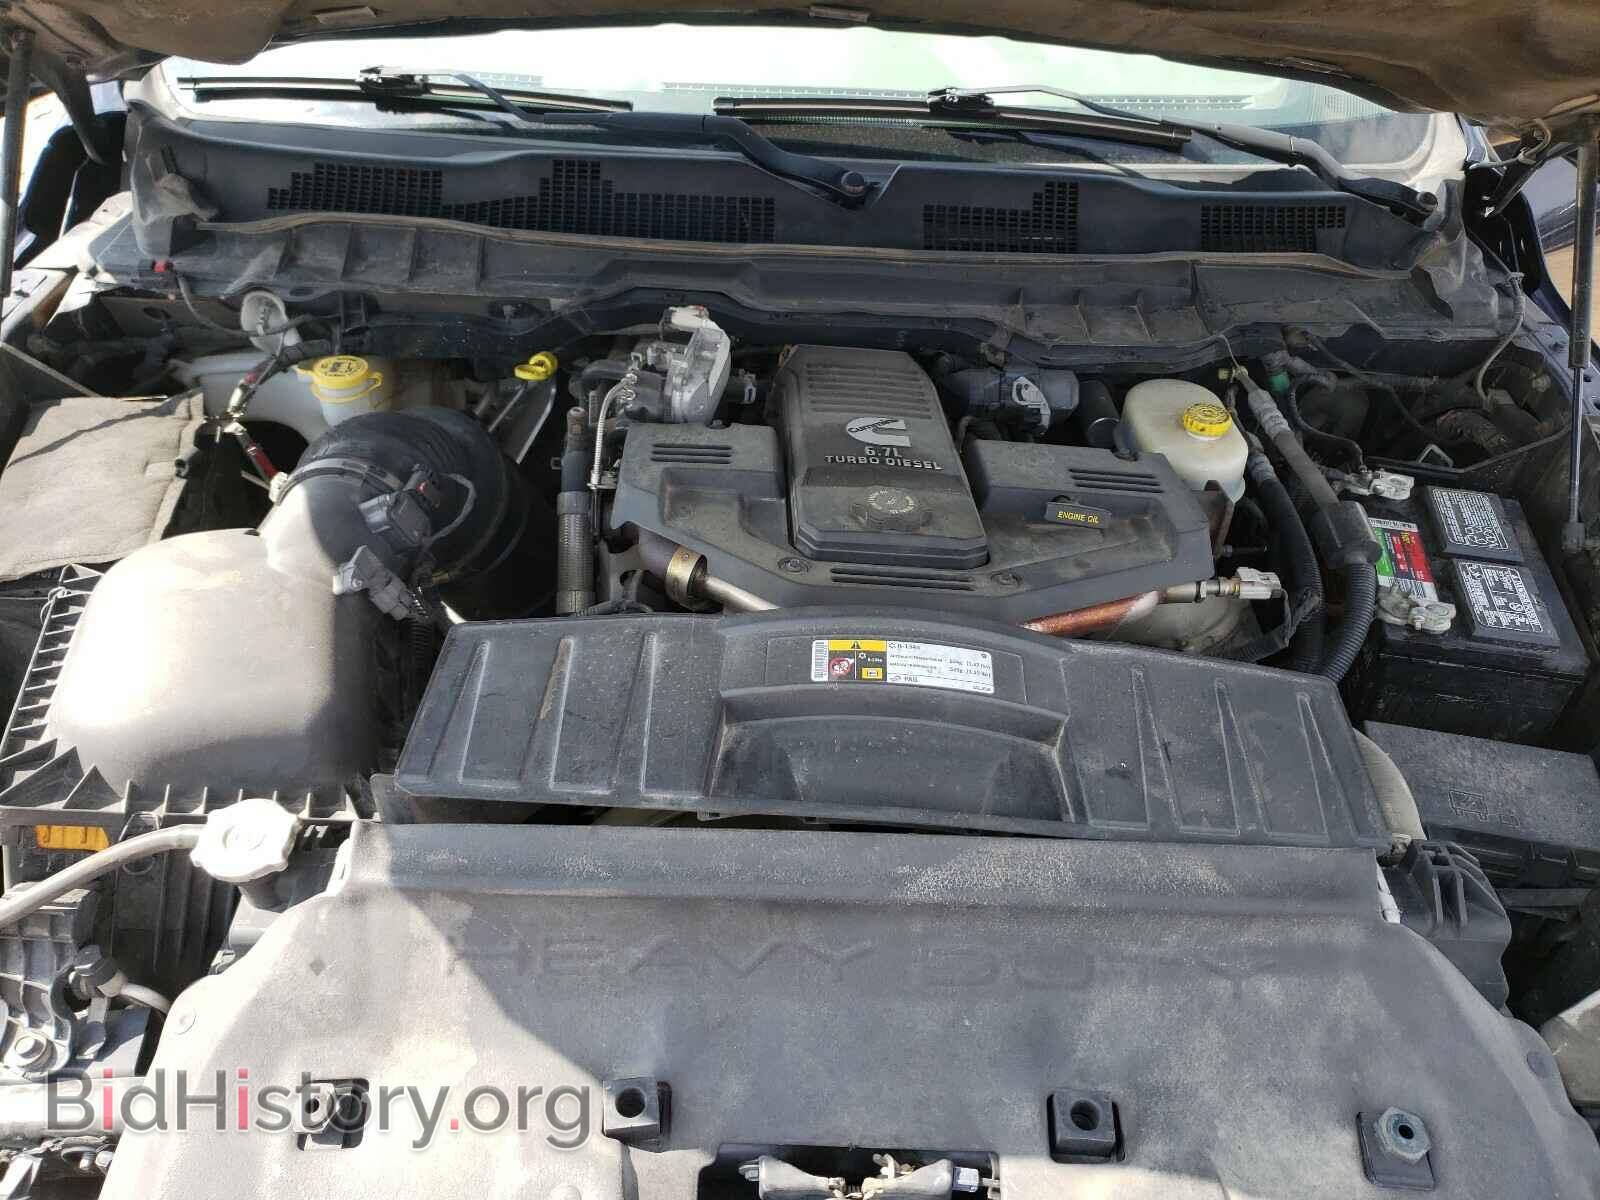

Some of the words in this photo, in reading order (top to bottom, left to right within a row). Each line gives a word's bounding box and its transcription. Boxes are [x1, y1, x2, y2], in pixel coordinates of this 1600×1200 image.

[864, 446, 902, 458] 6.7L
[825, 455, 880, 465] TURBO
[885, 457, 943, 470] DIESEL
[1057, 511, 1087, 522] ENGINE
[1087, 515, 1099, 524] OIL
